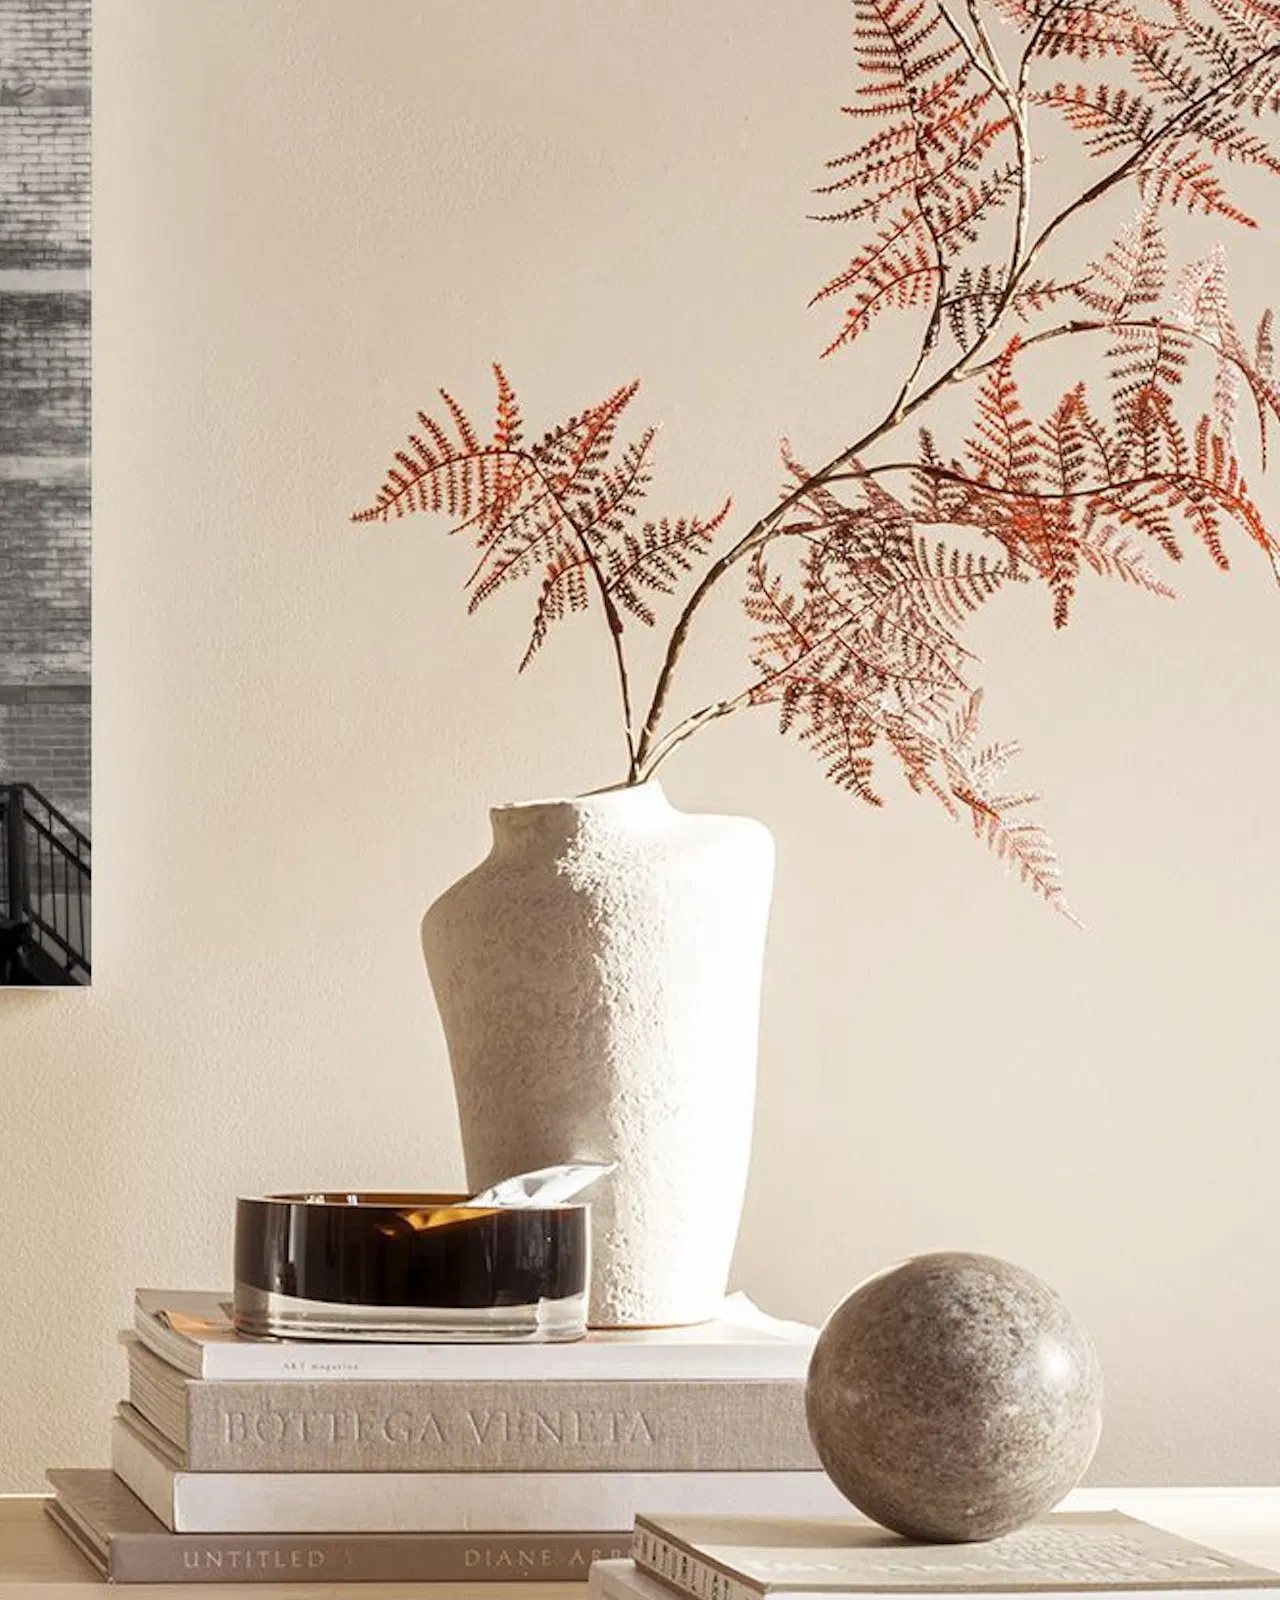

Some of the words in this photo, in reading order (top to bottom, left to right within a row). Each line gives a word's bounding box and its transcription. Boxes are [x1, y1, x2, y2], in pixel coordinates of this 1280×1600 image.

[222, 1410, 448, 1445] BOTTEGA
[466, 1410, 657, 1444] VENETA
[183, 1549, 326, 1569] UNTITLED
[463, 1548, 555, 1568] DIANE
